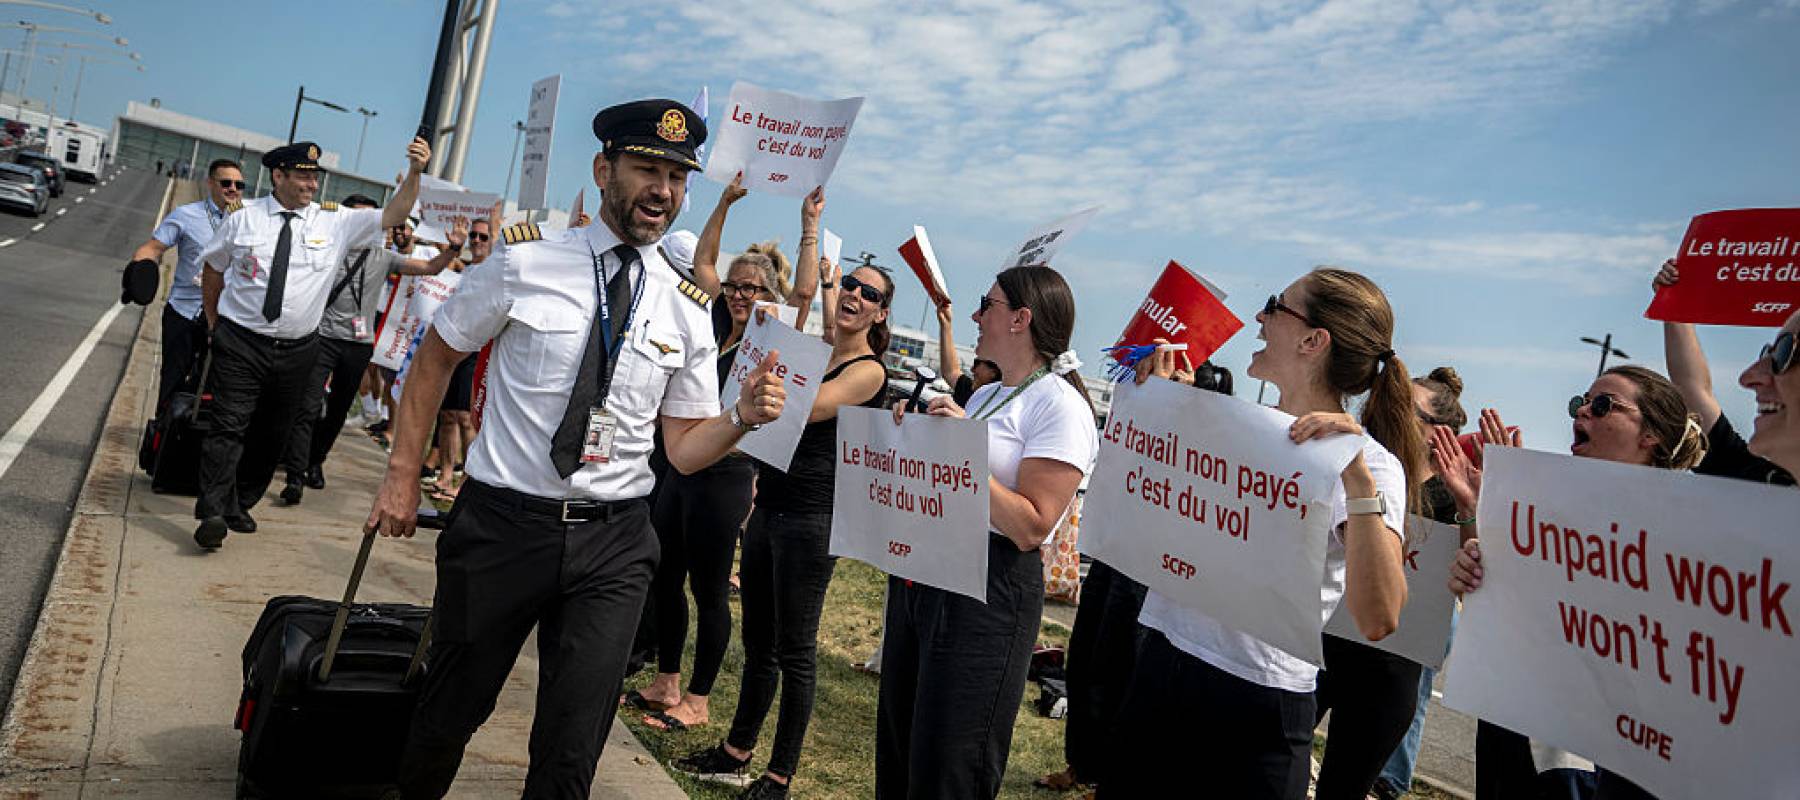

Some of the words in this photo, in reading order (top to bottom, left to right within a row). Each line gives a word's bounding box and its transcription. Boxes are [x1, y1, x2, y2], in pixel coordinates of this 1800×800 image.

[732, 104, 753, 125] Le
[757, 112, 801, 136] travail
[801, 126, 823, 139] non
[758, 136, 790, 155] c'est
[789, 141, 807, 158] du
[808, 144, 827, 160] vol
[1687, 238, 1713, 257] Le
[1716, 236, 1790, 257] travail
[1716, 262, 1773, 282] c'est
[1751, 302, 1792, 313] SCFP
[842, 440, 861, 465] Le
[863, 444, 897, 474] travail
[899, 457, 926, 480] non
[931, 459, 978, 495] payé,
[1104, 412, 1121, 441] Le
[1125, 419, 1178, 467] travail
[1186, 446, 1228, 484] non
[1237, 466, 1308, 519] payé,
[869, 480, 894, 508] c'est
[896, 486, 914, 512] du
[919, 491, 944, 519] vol
[1126, 466, 1172, 511] c'est
[1177, 484, 1206, 524] du
[1214, 502, 1250, 542] vol
[888, 540, 911, 556] SCFP
[1161, 553, 1197, 581] SCFP
[1510, 500, 1650, 593] Unpaid
[1665, 551, 1794, 638] work
[1558, 601, 1672, 684] won't
[1686, 630, 1745, 726] fly
[1615, 713, 1674, 762] CUPE
